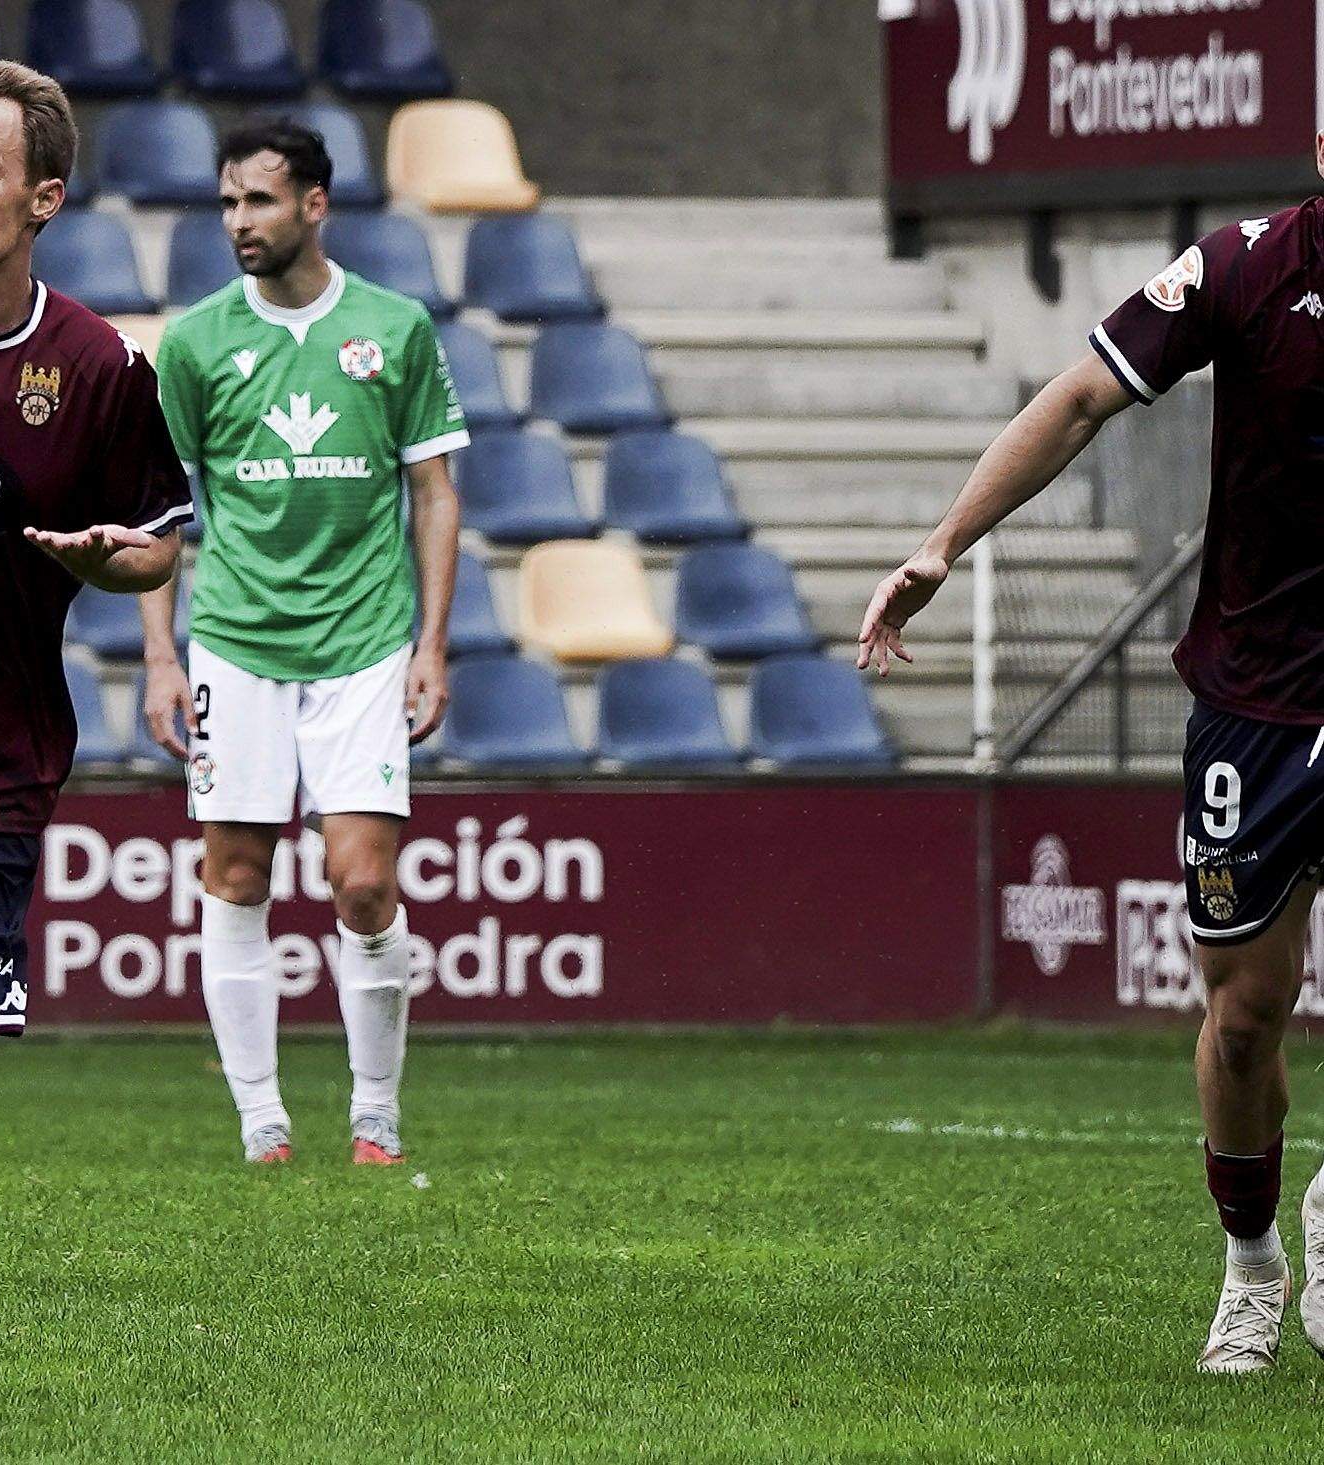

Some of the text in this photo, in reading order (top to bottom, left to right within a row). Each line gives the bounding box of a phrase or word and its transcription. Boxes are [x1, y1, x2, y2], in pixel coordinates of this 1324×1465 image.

[1049, 31, 1263, 137] Pontevedra
[292, 455, 373, 479] RURAL
[1202, 762, 1242, 839] 9
